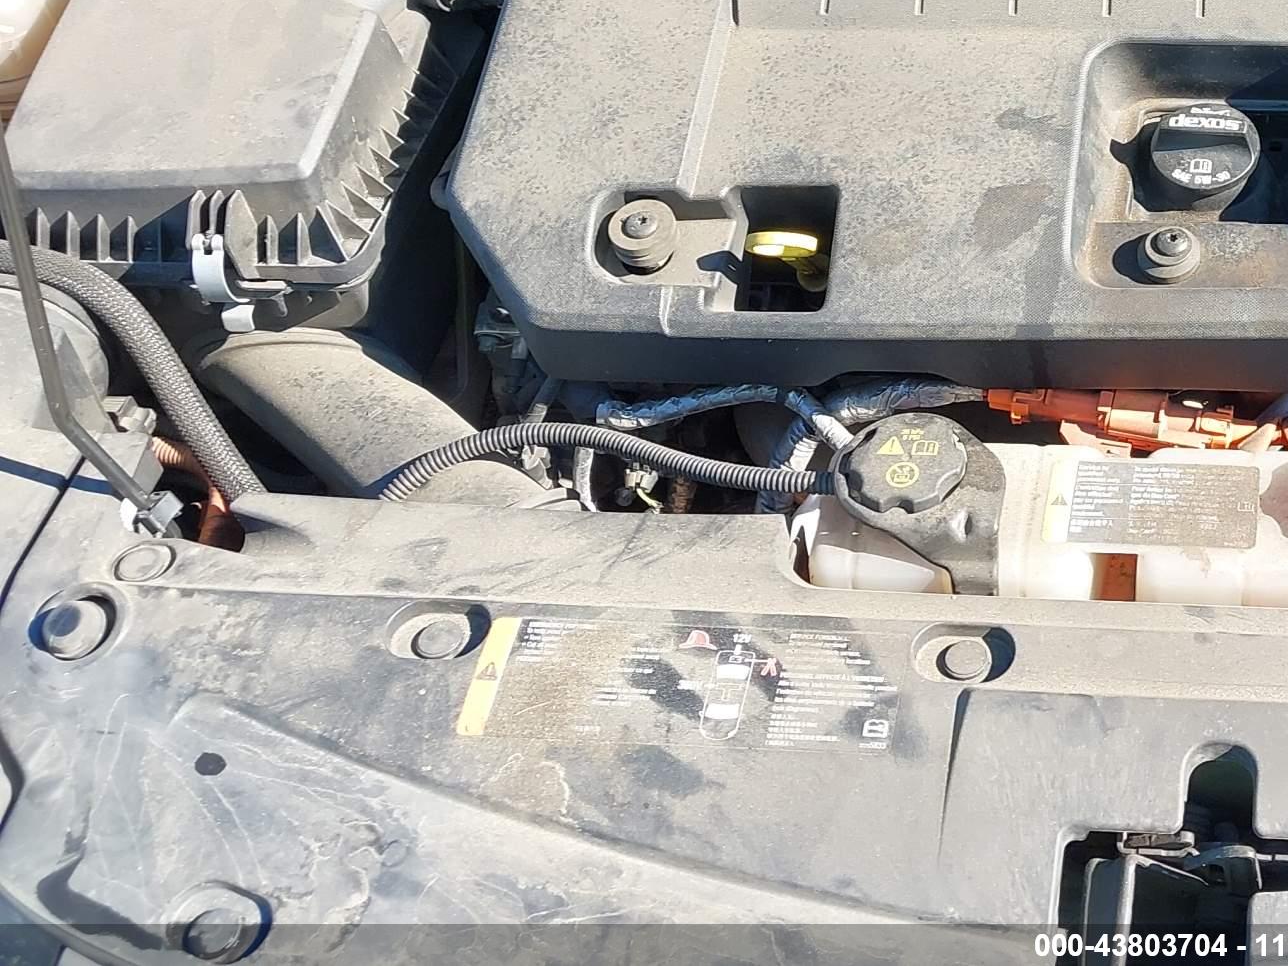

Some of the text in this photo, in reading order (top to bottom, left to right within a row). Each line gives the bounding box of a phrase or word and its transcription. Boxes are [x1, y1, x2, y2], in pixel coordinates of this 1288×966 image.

[1169, 114, 1241, 131] dexos
[1171, 169, 1193, 183] SAE
[733, 634, 752, 643] 12V
